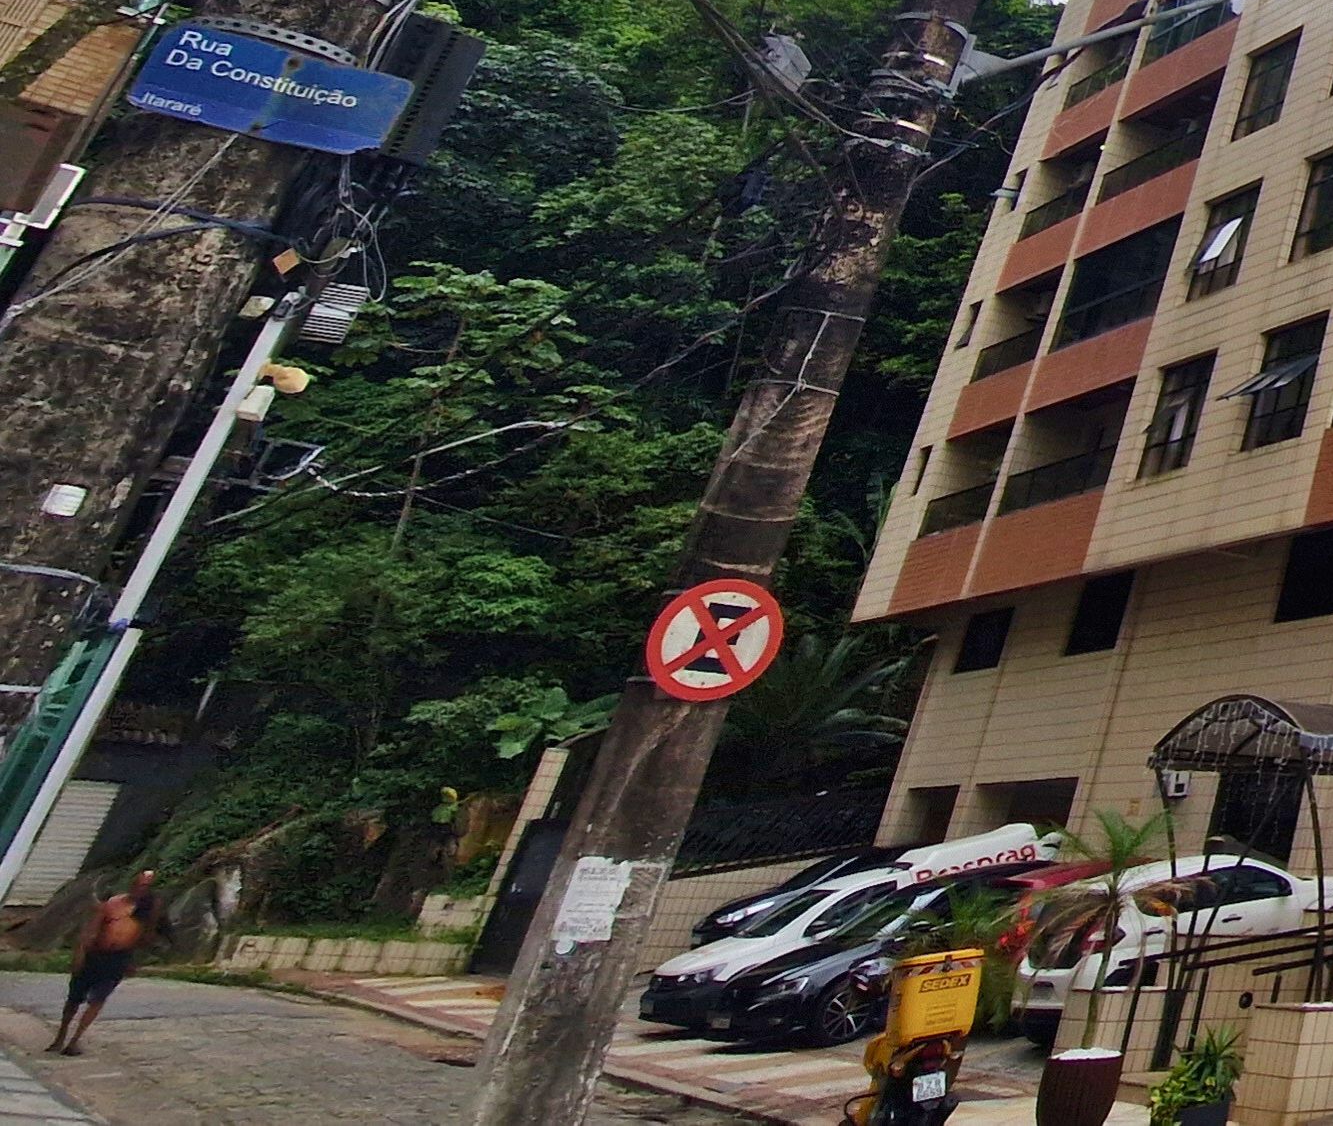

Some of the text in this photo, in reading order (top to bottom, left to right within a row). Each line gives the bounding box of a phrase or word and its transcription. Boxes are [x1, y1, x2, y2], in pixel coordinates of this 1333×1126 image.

[178, 30, 233, 56] Rua
[165, 48, 358, 108] Da Constituição
[921, 975, 970, 992] SEDEX
